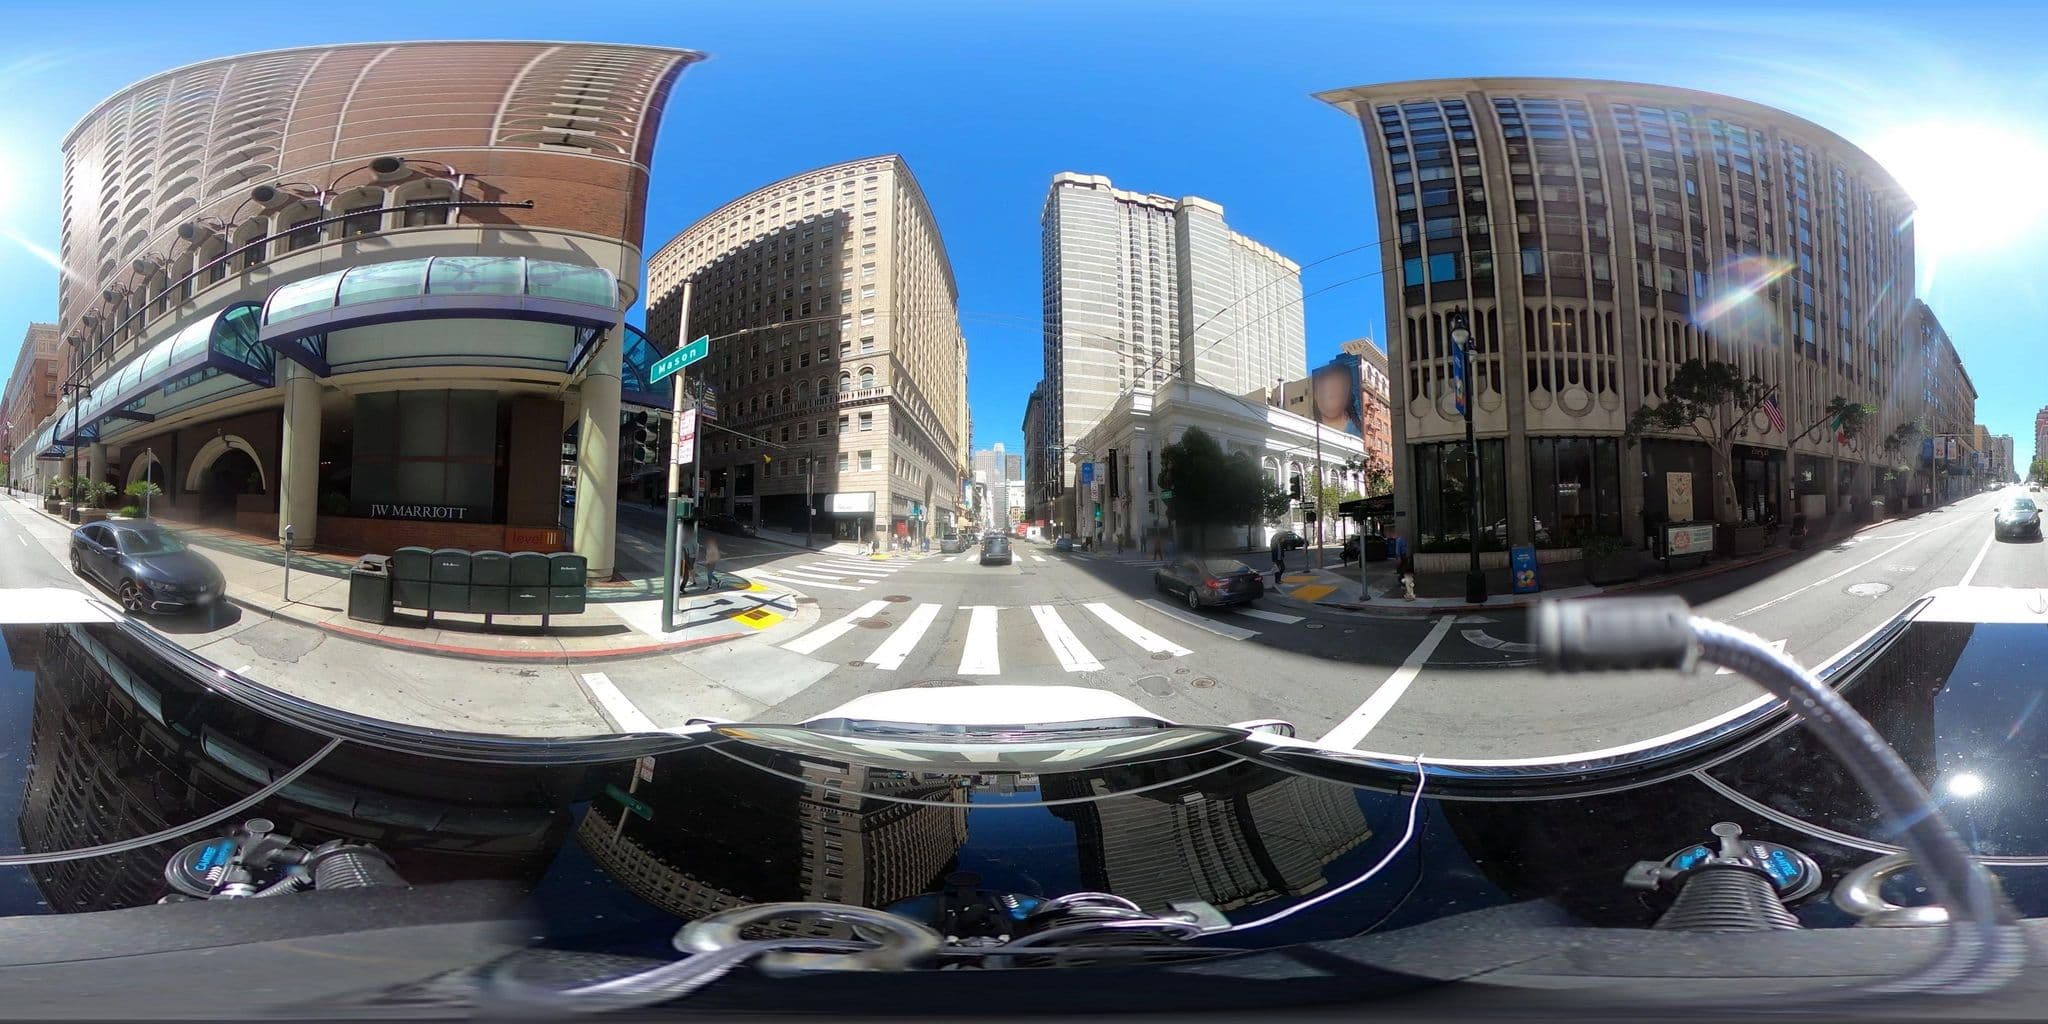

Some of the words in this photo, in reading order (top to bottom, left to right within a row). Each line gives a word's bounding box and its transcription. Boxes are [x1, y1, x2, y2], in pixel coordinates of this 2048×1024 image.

[658, 348, 696, 375] Mason
[371, 504, 389, 518] JW
[391, 504, 467, 519] MARRIOTT
